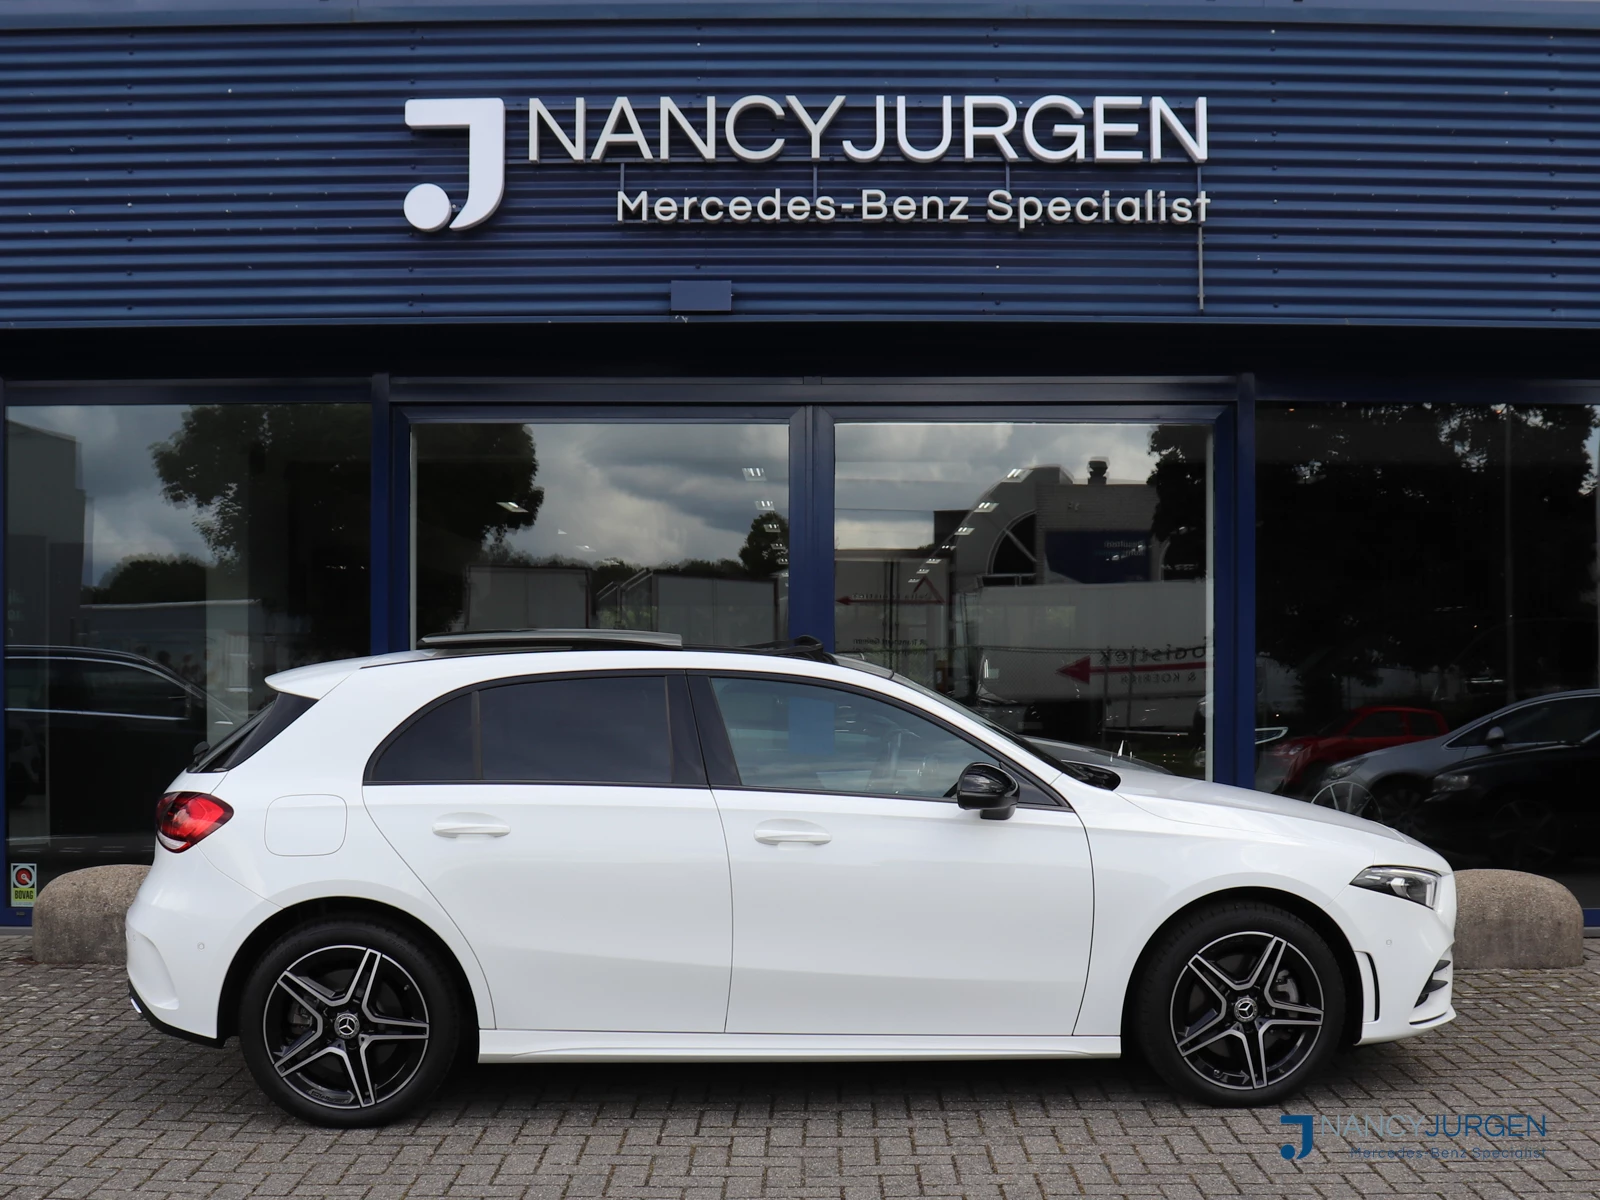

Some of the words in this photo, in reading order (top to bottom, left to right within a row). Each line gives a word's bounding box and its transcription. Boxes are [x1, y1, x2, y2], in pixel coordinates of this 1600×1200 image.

[528, 95, 1209, 163] NANCYJURGEN
[617, 188, 970, 223] Mercedes-Benz
[986, 189, 1211, 231] Specialist
[14, 890, 34, 900] BOVAG
